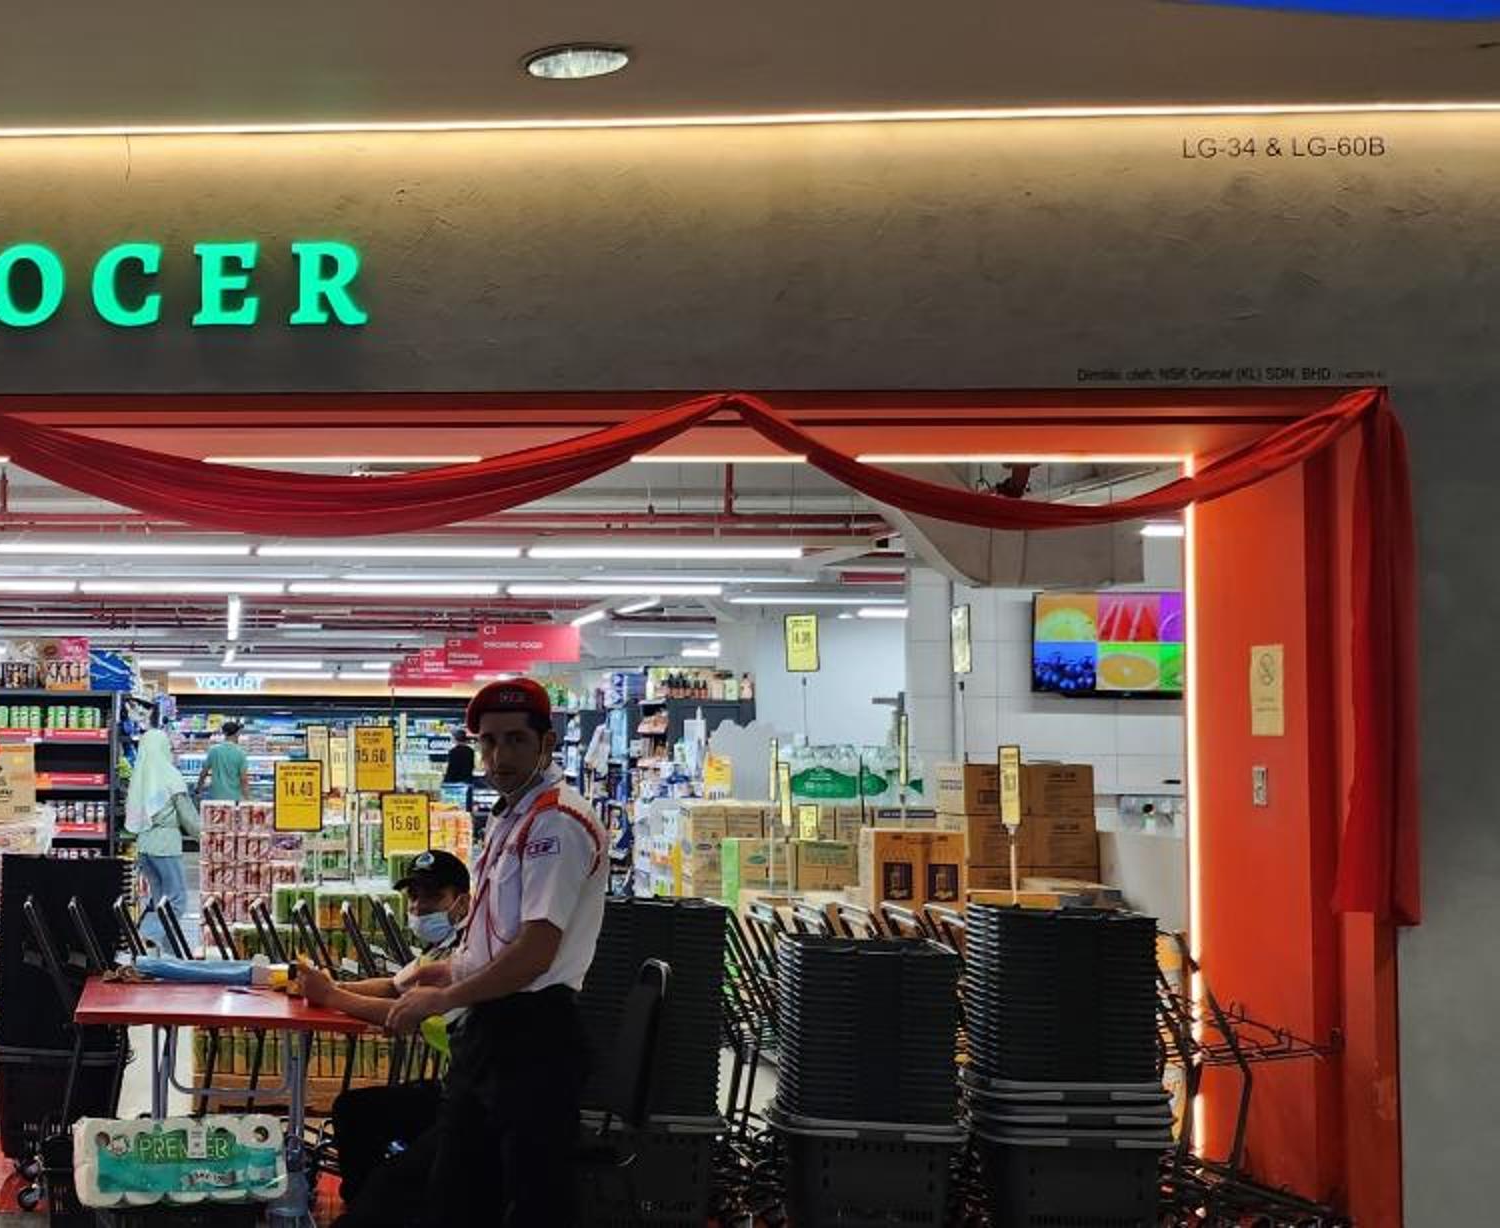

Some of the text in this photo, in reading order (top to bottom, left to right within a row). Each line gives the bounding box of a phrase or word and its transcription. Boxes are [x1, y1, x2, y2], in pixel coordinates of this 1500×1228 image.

[1182, 136, 1386, 158] LG-34 & LG-60B
[195, 675, 264, 689] YOGURT
[138, 1136, 229, 1161] PREER
